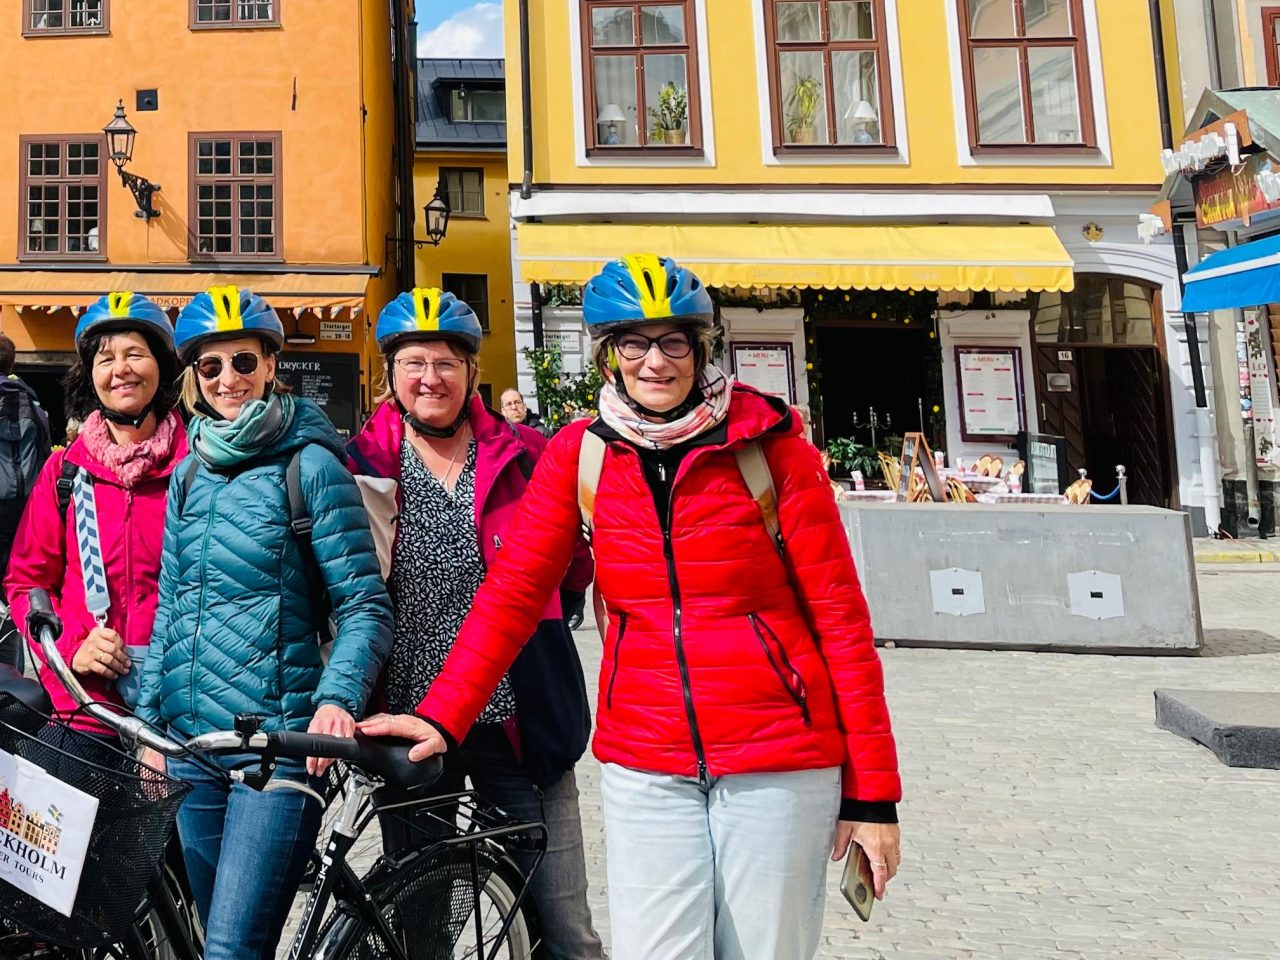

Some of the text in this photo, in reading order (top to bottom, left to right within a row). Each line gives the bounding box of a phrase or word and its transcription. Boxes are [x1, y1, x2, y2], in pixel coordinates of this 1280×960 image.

[1060, 352, 1070, 360] 16
[278, 361, 321, 371] DRYCKER
[14, 860, 44, 884] TOURS
